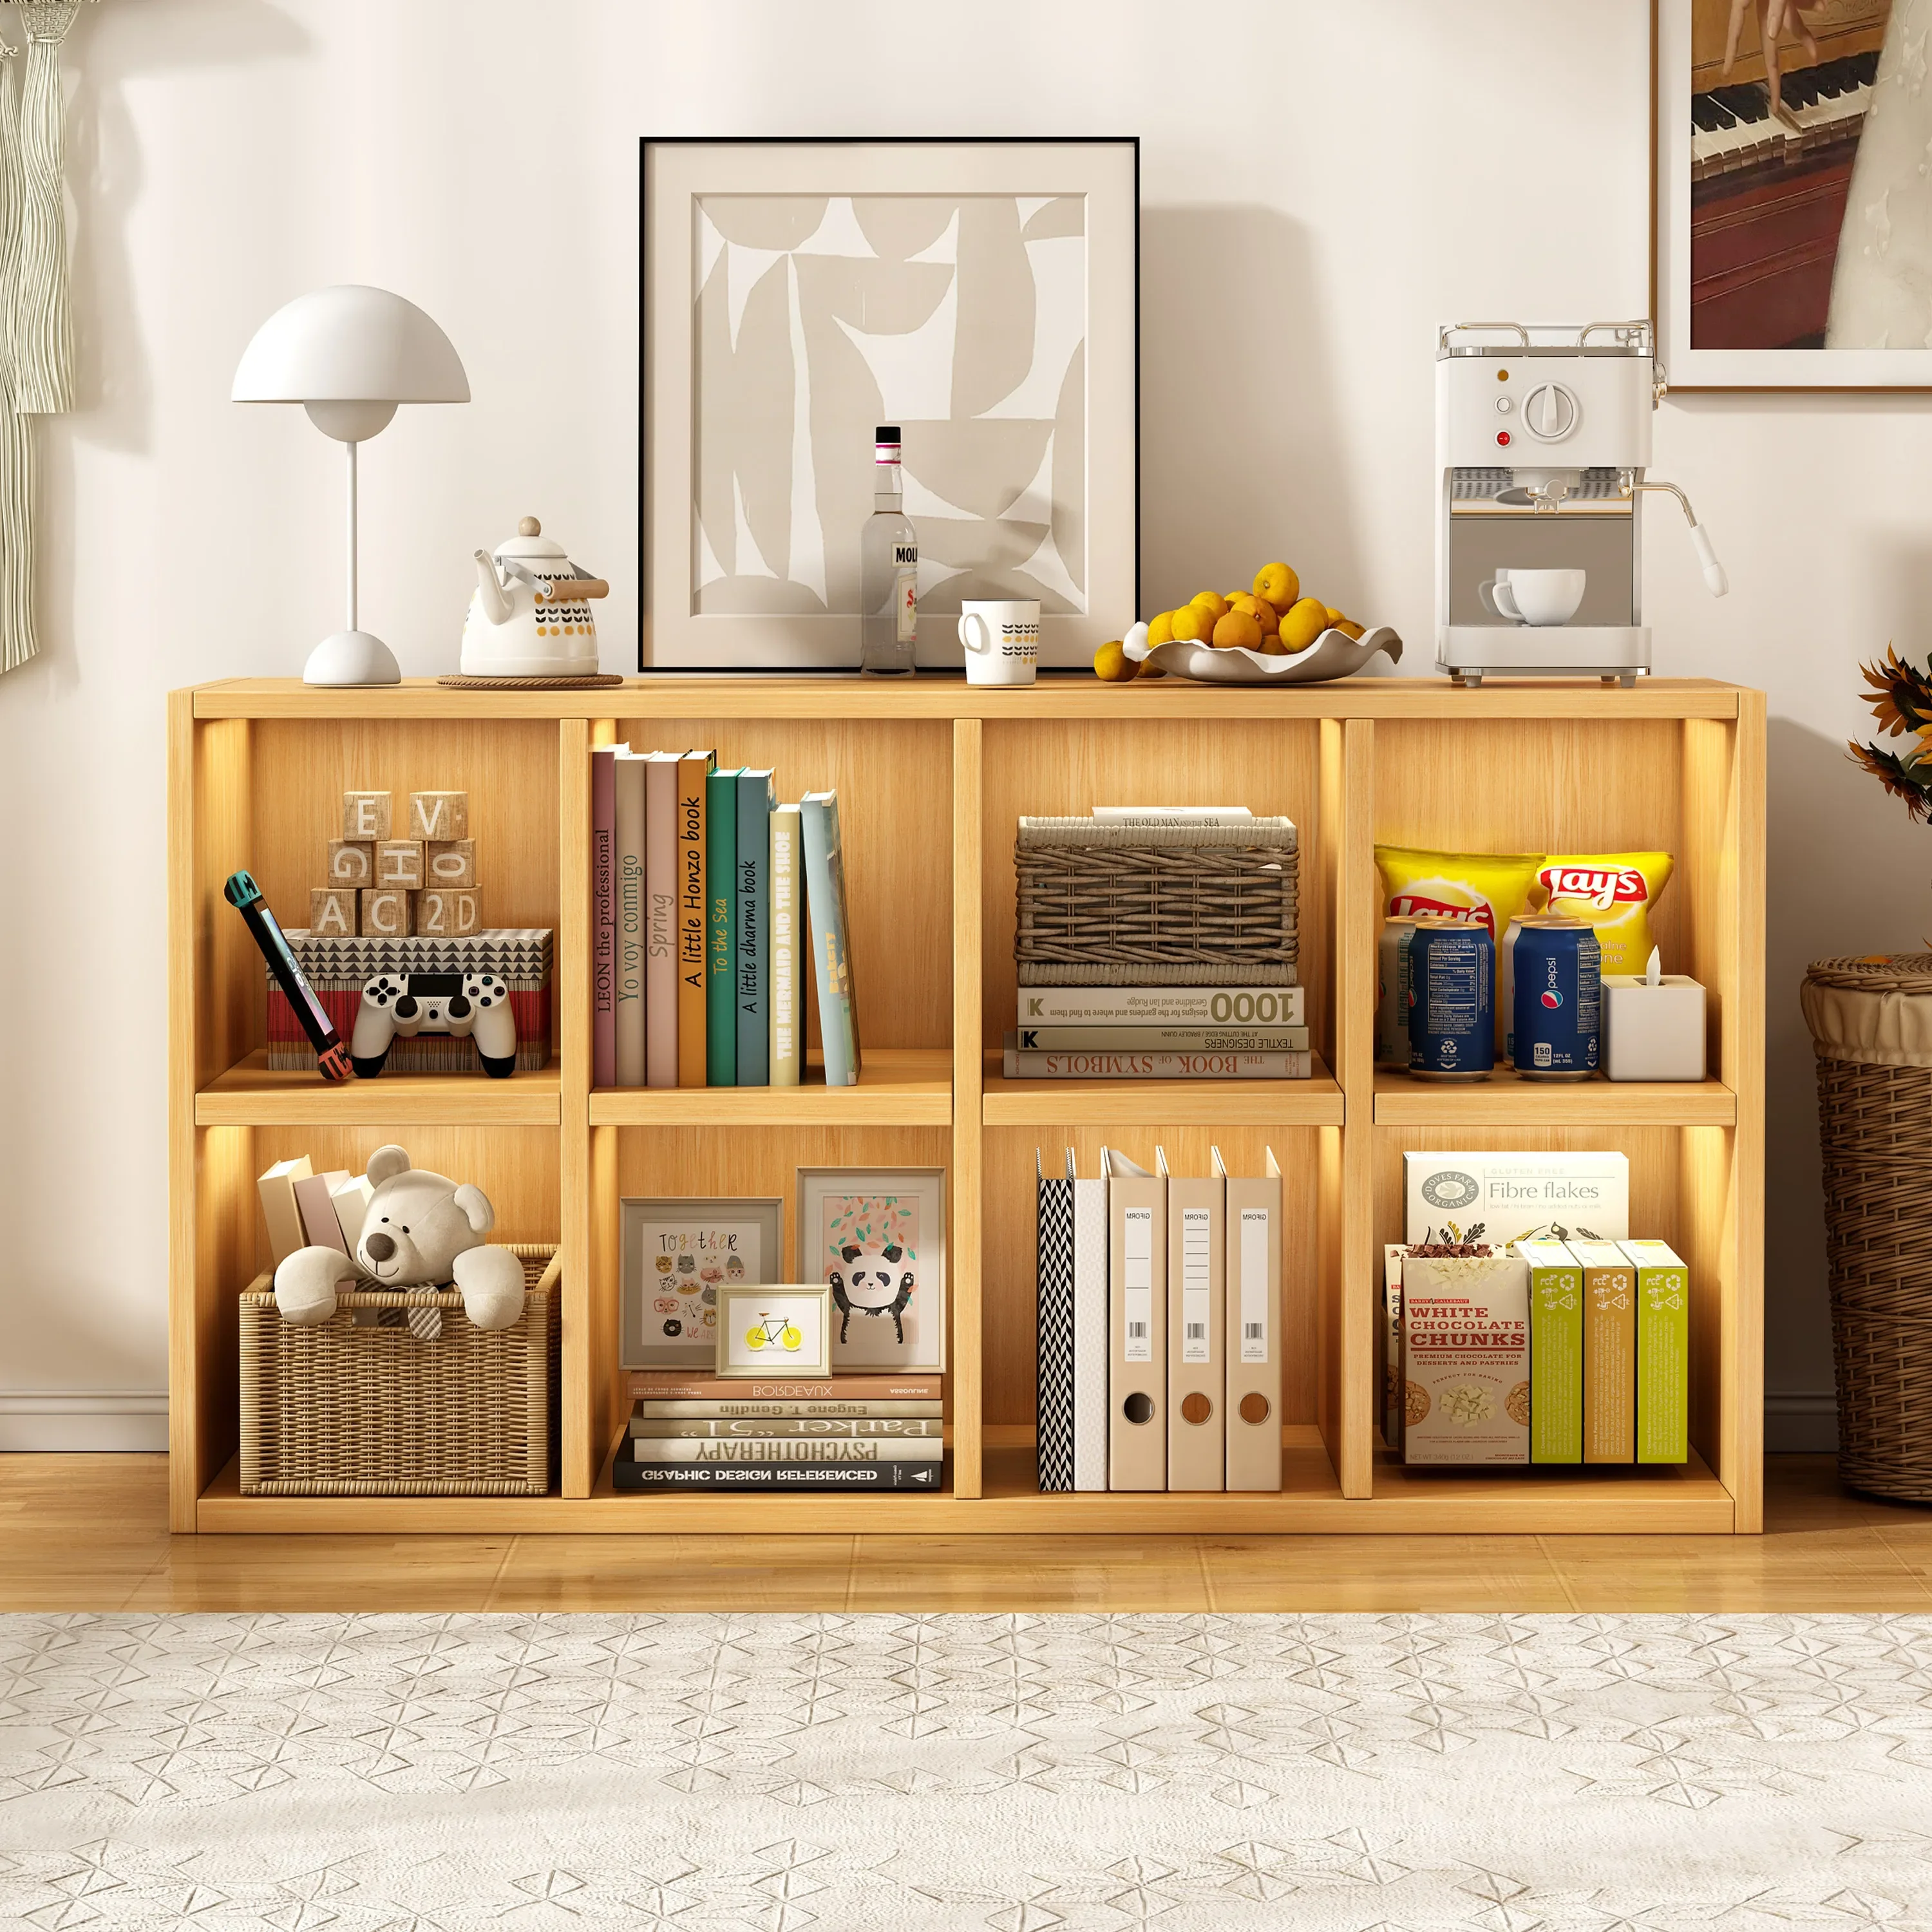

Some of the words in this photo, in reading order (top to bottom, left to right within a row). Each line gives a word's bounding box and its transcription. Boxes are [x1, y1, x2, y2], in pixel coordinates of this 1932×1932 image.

[357, 799, 375, 835] E
[416, 800, 443, 835] V
[681, 797, 700, 841] book
[1123, 817, 1141, 827] THE
[1142, 817, 1160, 827] OLD
[1161, 817, 1179, 827] MAN
[1204, 817, 1220, 827] SEA
[775, 831, 790, 873] SHOE
[334, 847, 368, 878] G
[383, 849, 417, 880] H
[432, 853, 466, 877] O
[596, 829, 615, 926] professional
[684, 849, 702, 909] Honzo
[739, 860, 756, 893] book
[620, 855, 642, 934] conmigo
[775, 875, 791, 909] THE
[1550, 868, 1640, 911] Lay's
[317, 896, 348, 932] A
[372, 896, 397, 932] C
[427, 895, 444, 931] 2
[459, 895, 476, 931] D
[713, 898, 728, 922] Sea
[648, 893, 674, 958] Spring
[741, 898, 756, 956] dharma
[775, 911, 791, 945] AND
[598, 936, 611, 956] the
[683, 917, 701, 963] little
[714, 927, 728, 953] the
[625, 940, 643, 972] voy
[713, 956, 728, 974] To
[684, 972, 701, 988] A
[741, 960, 756, 997] little
[1547, 958, 1558, 989] pepsi
[598, 967, 611, 1013] LEON
[619, 974, 639, 1003] Yo
[775, 949, 792, 1023] MERMAID
[742, 1001, 757, 1014] A
[1127, 997, 1148, 1007] Rudge
[1150, 997, 1160, 1007] Ian
[1162, 997, 1174, 1007] and
[1175, 997, 1207, 1007] Geraldine
[1211, 992, 1294, 1023] 1000
[1050, 1008, 1068, 1017] them
[1069, 1008, 1083, 1017] find
[1084, 1008, 1091, 1017] to
[1092, 1008, 1113, 1017] where
[1115, 1008, 1128, 1017] and
[1129, 1008, 1157, 1017] gardens
[1158, 1008, 1170, 1017] the
[1171, 1008, 1180, 1017] for
[1182, 1008, 1208, 1017] designs
[777, 1024, 792, 1061] THE
[1204, 1039, 1255, 1048] DESIGNERS
[1257, 1039, 1293, 1048] TEXTILE
[1046, 1056, 1153, 1074] SYMBOLS
[1158, 1056, 1172, 1065] OF
[1177, 1055, 1238, 1074] BOOK
[1244, 1056, 1264, 1065] THE
[1425, 1173, 1452, 1193] DOVES
[1454, 1174, 1475, 1189] FARM
[1490, 1182, 1537, 1198] Fibre
[1543, 1181, 1599, 1198] flakes
[1428, 1194, 1473, 1207] ORGANIC
[1409, 1308, 1488, 1318] WHITE
[1410, 1321, 1525, 1330] CHOCOLATE
[1410, 1334, 1525, 1346] CHUNKS
[1432, 1374, 1461, 1384] PERFECT
[719, 1405, 784, 1415] Gendlin
[808, 1401, 867, 1415] Eugene
[788, 1419, 931, 1437] Parker
[694, 1441, 877, 1461] PSYCHOTHERAPY
